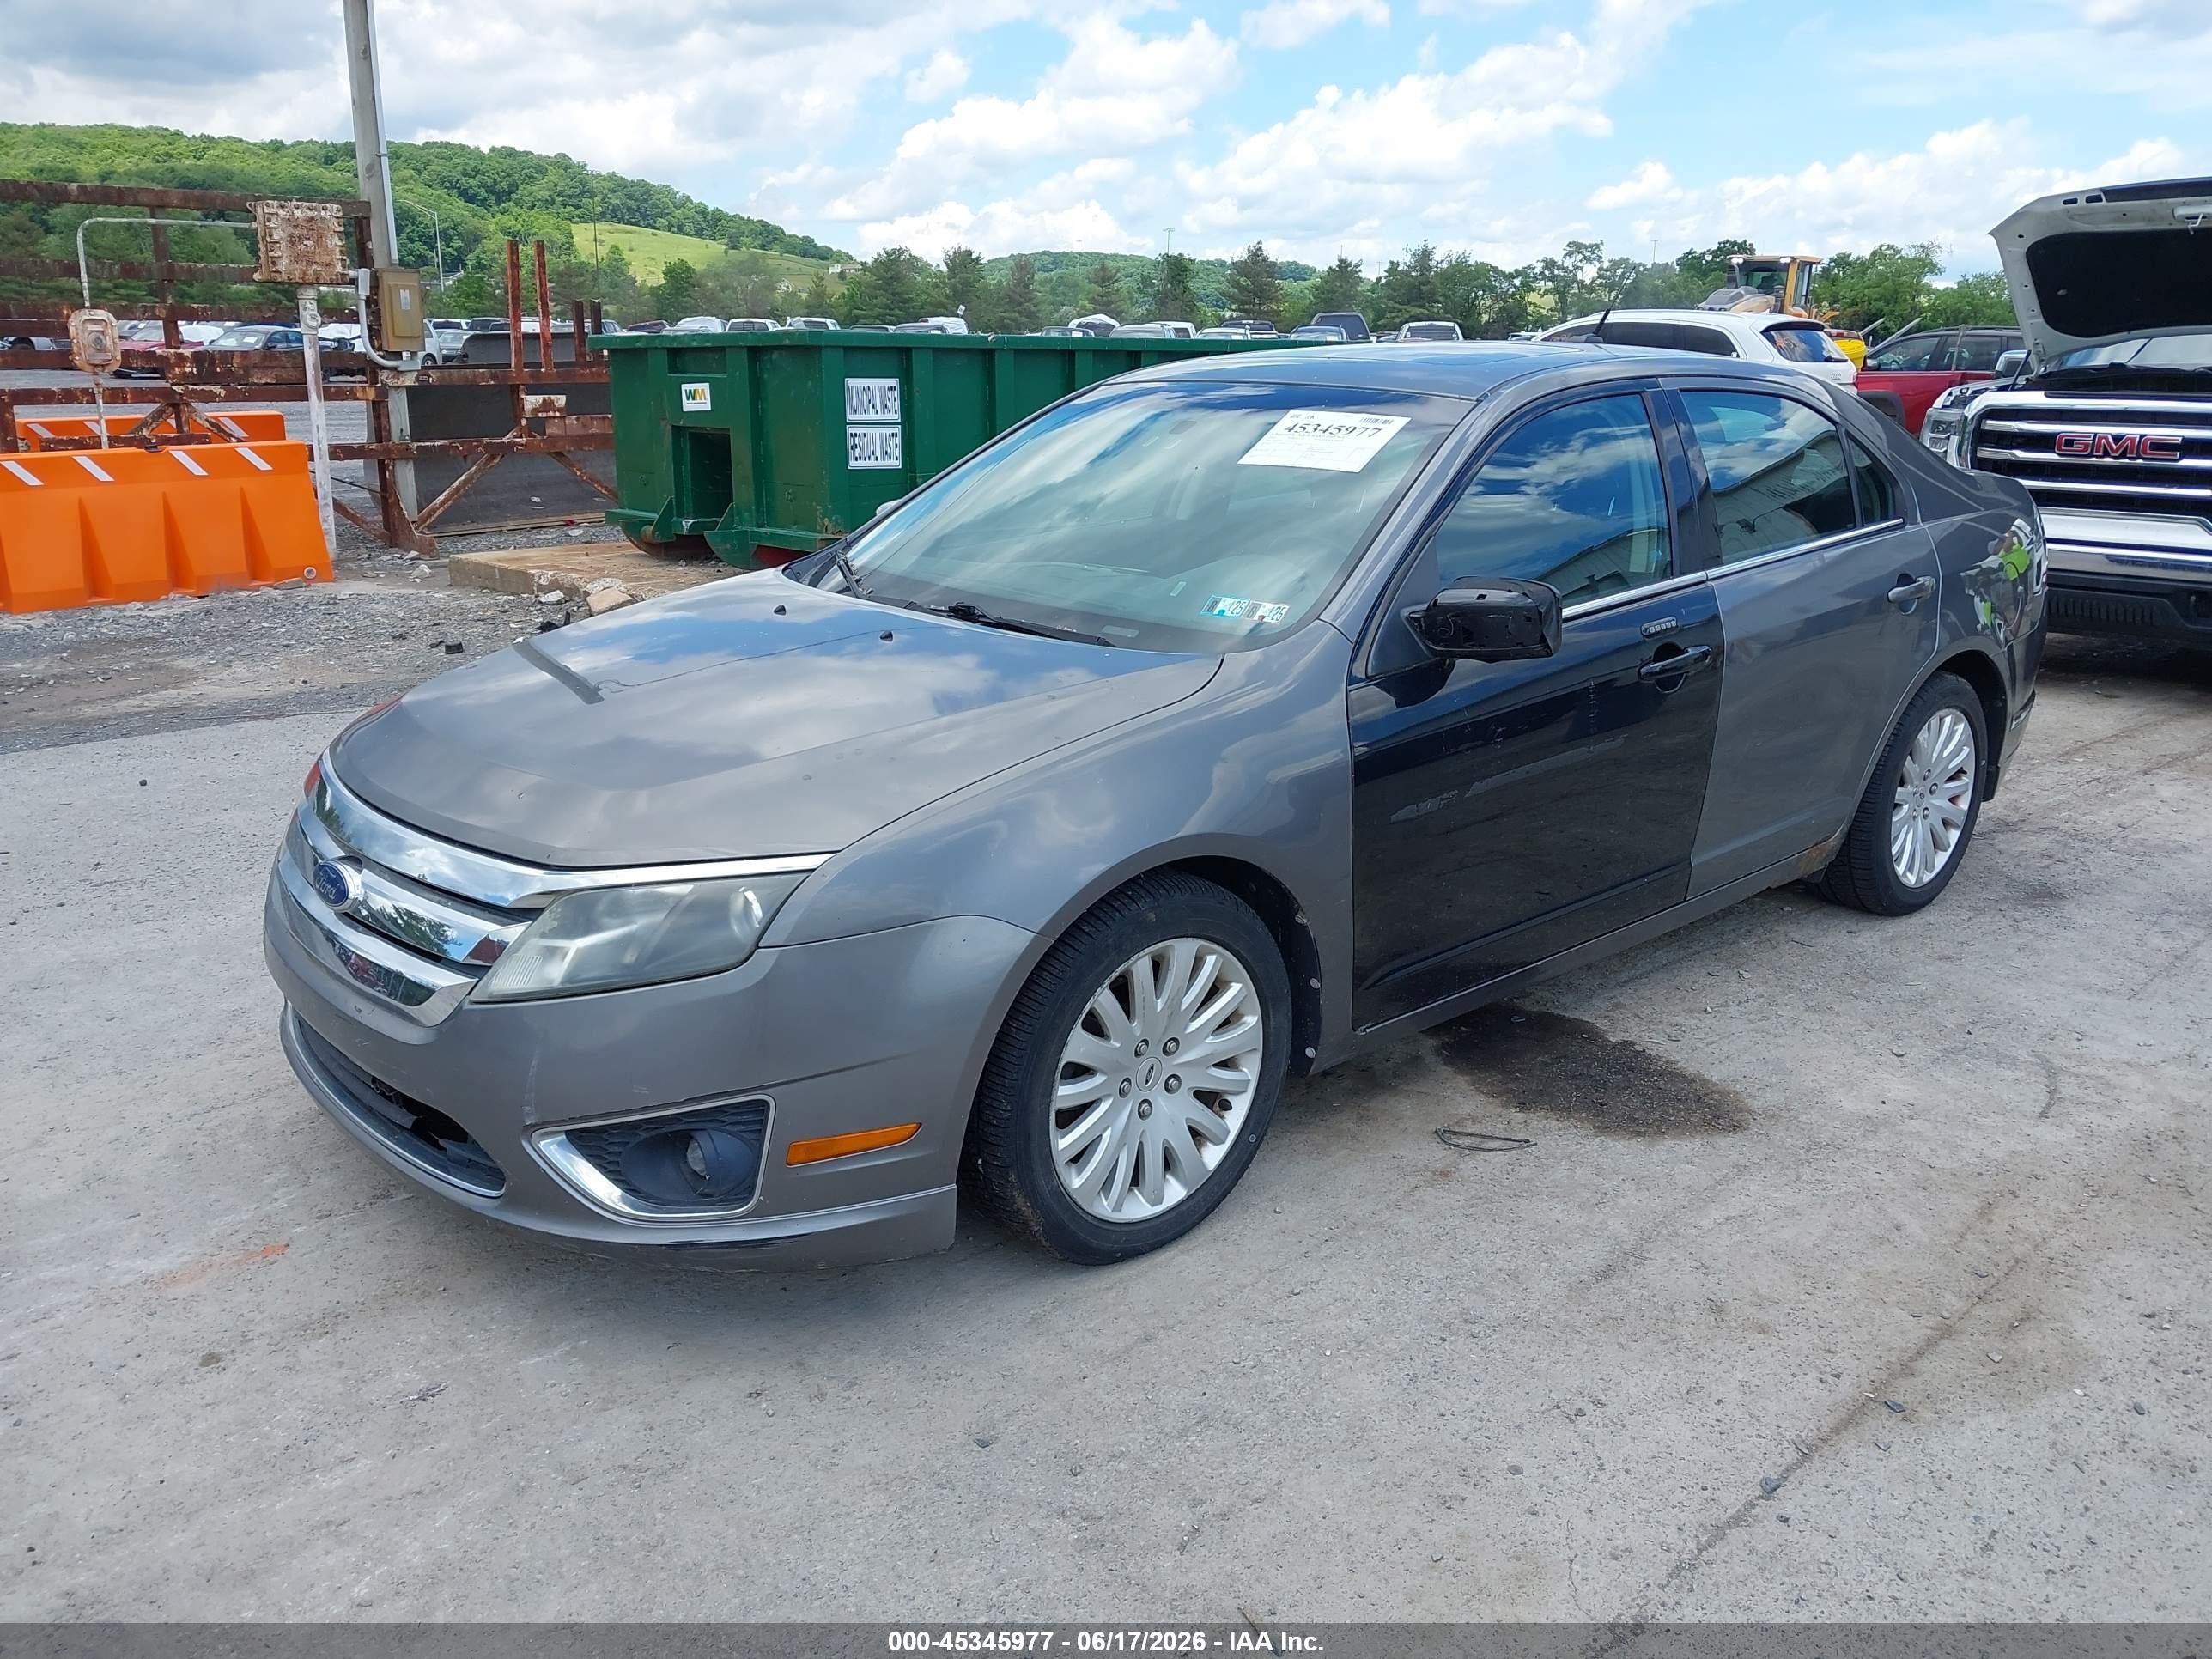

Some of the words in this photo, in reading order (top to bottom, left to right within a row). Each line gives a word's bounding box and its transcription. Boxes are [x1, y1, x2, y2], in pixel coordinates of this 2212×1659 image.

[684, 388, 707, 401] WM
[848, 386, 878, 415] MUNICIPAL
[878, 386, 897, 415] WASTE
[1285, 423, 1383, 437] 45345977
[850, 432, 878, 462] RESIDUAL
[879, 432, 899, 462] WASTE
[2055, 432, 2184, 459] GMC
[315, 866, 340, 901] Ford
